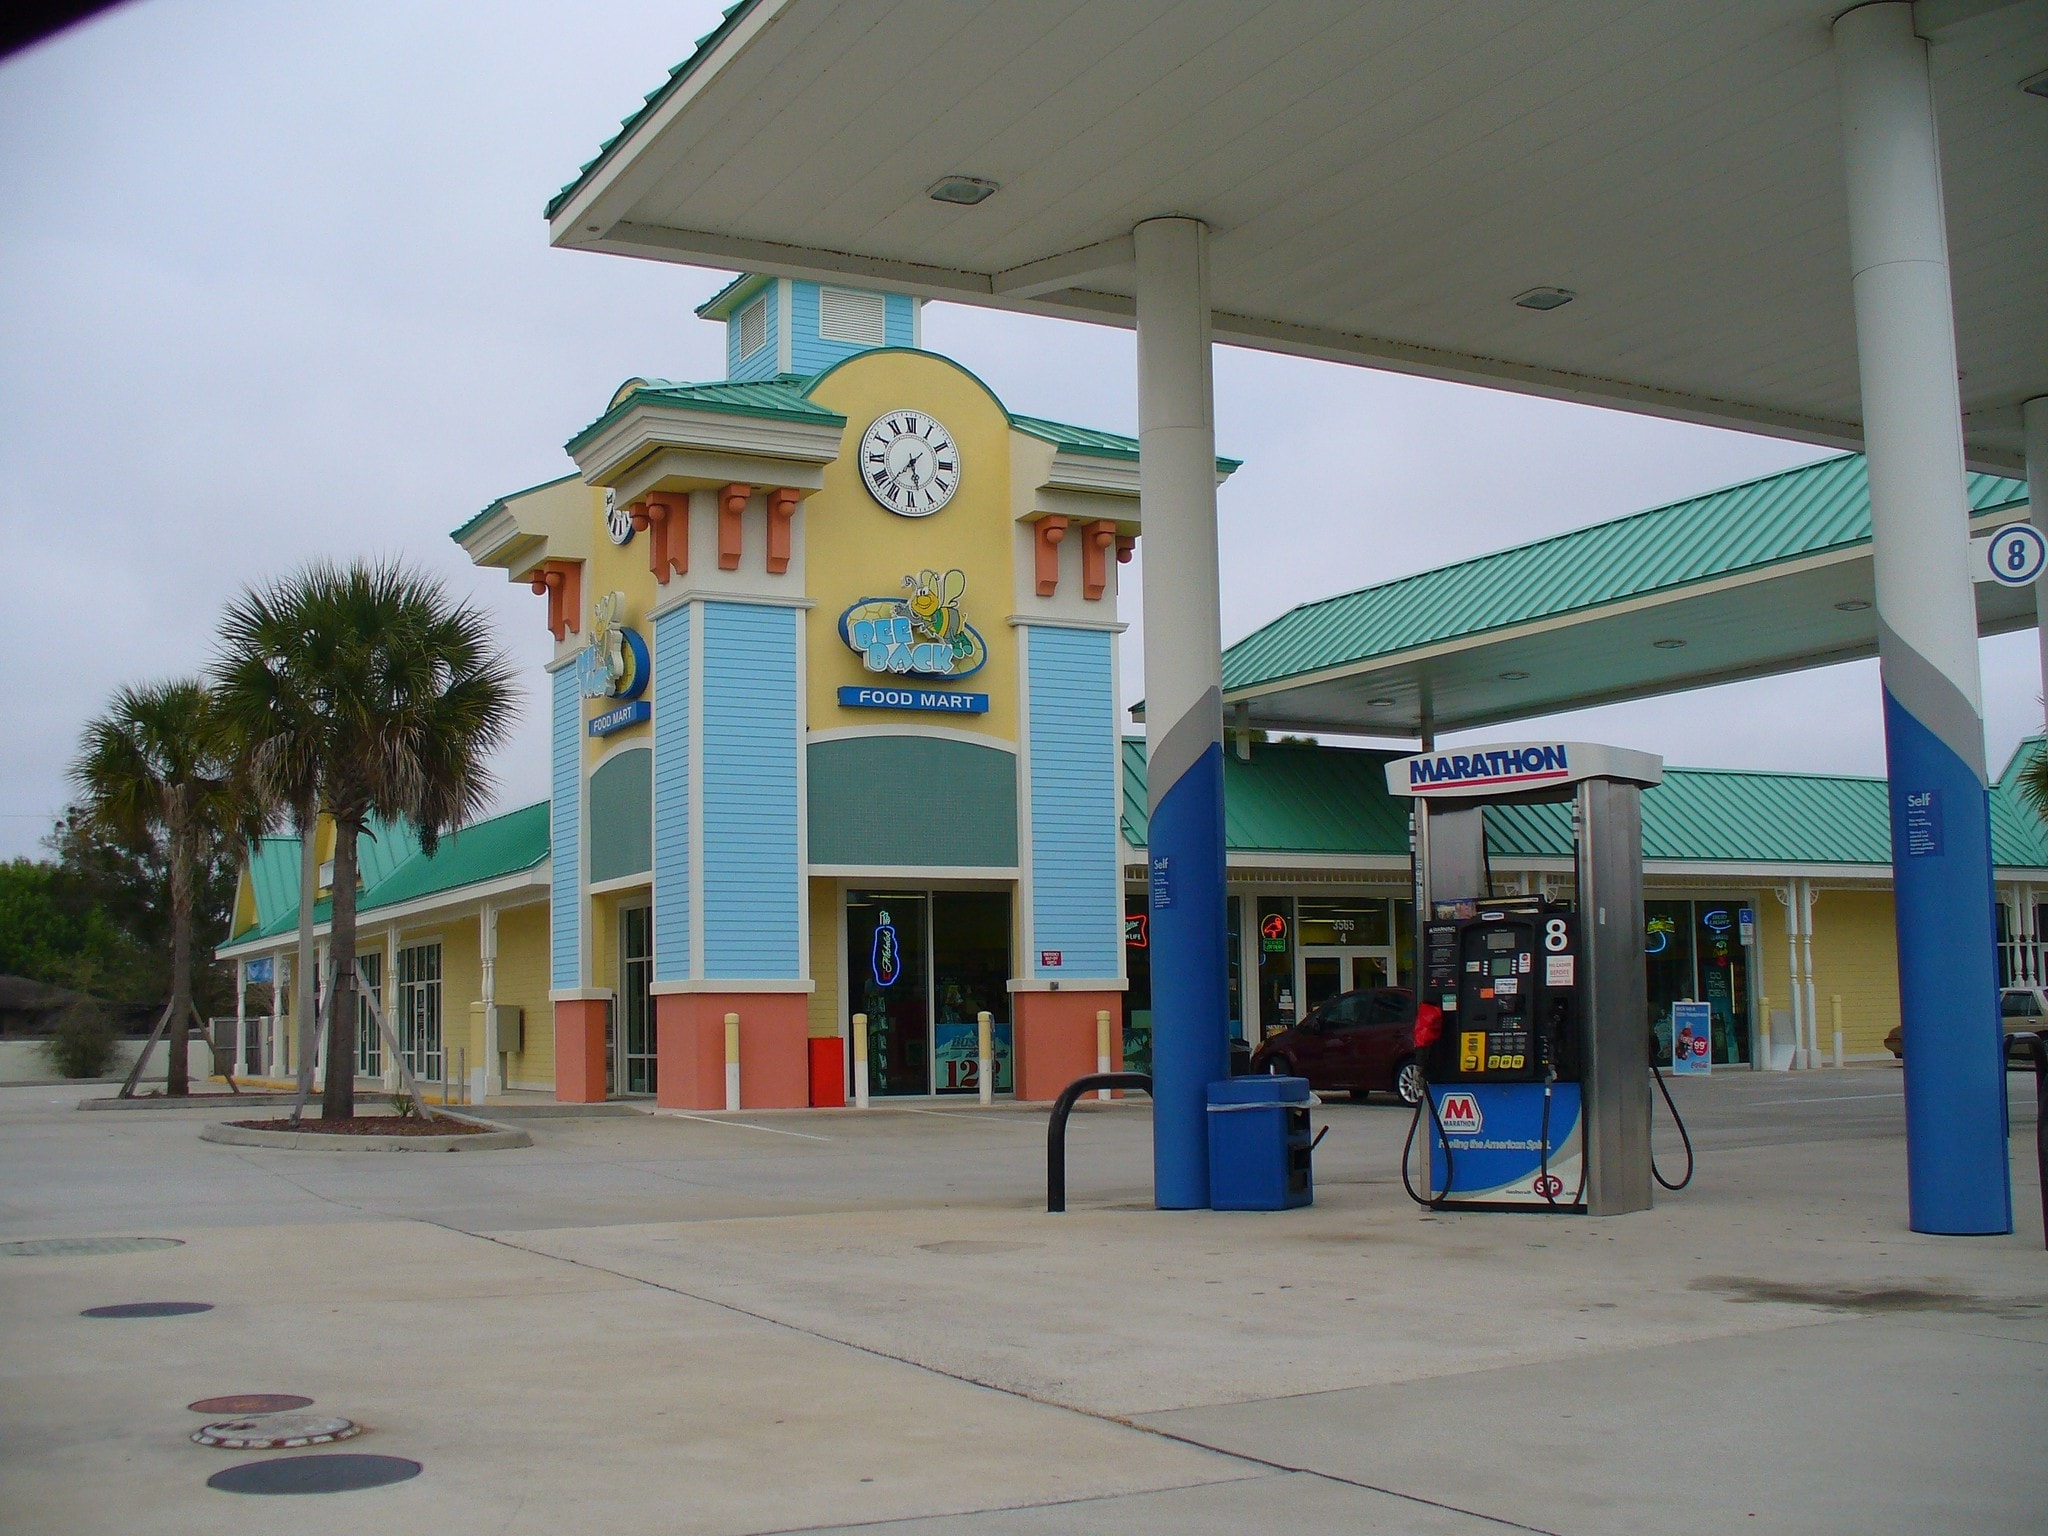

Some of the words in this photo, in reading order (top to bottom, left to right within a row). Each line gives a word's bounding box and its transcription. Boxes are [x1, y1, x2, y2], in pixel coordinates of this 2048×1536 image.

[2007, 539, 2025, 571] 8
[853, 617, 914, 650] BEE
[867, 641, 954, 674] BACK
[859, 690, 913, 705] FOOD
[920, 693, 974, 709] MART
[593, 715, 612, 732] FOOD
[612, 706, 632, 725] MART
[1410, 745, 1568, 784] MARATHON
[1908, 793, 1931, 806] Self
[1154, 858, 1169, 870] Self
[1333, 920, 1355, 931] 3565
[1545, 919, 1568, 951] 8
[1340, 933, 1347, 944] 4
[1445, 1099, 1474, 1119] M
[1469, 1139, 1484, 1149] the
[1484, 1139, 1526, 1149] American
